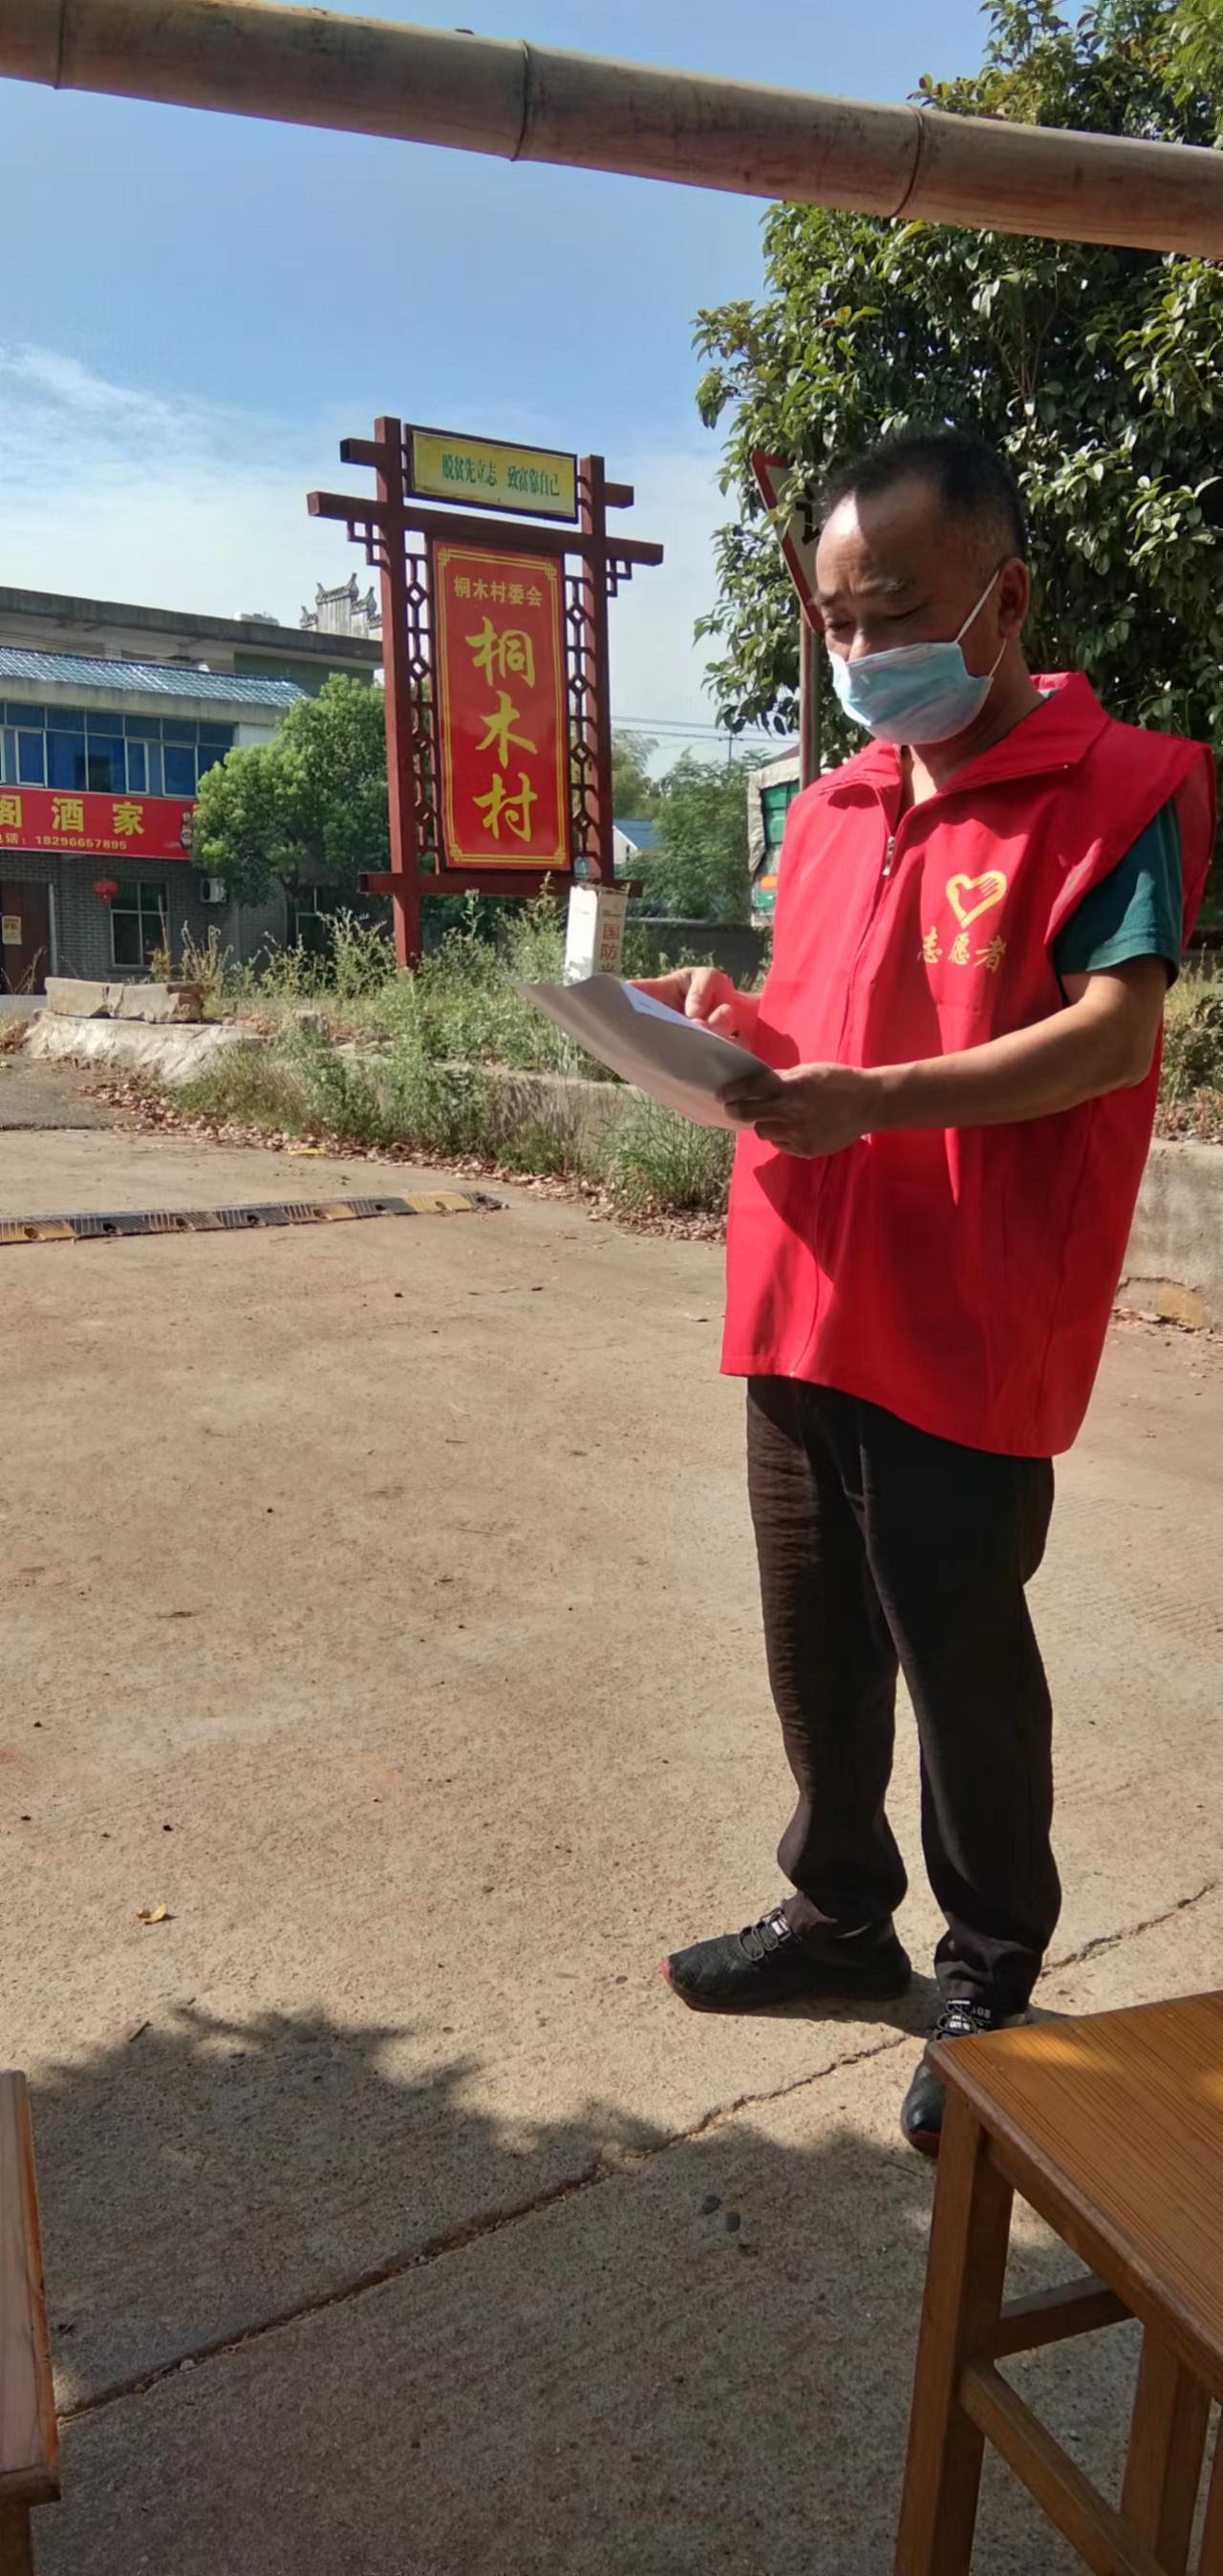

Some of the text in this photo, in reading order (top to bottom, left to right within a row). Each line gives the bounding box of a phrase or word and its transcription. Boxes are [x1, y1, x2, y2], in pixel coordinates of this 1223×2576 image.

[441, 453, 560, 497] 脱贫先立志 致富靠自己
[454, 574, 543, 608] 桐木村委会
[464, 614, 539, 843] 桐木村
[916, 925, 1007, 974] 志愿者
